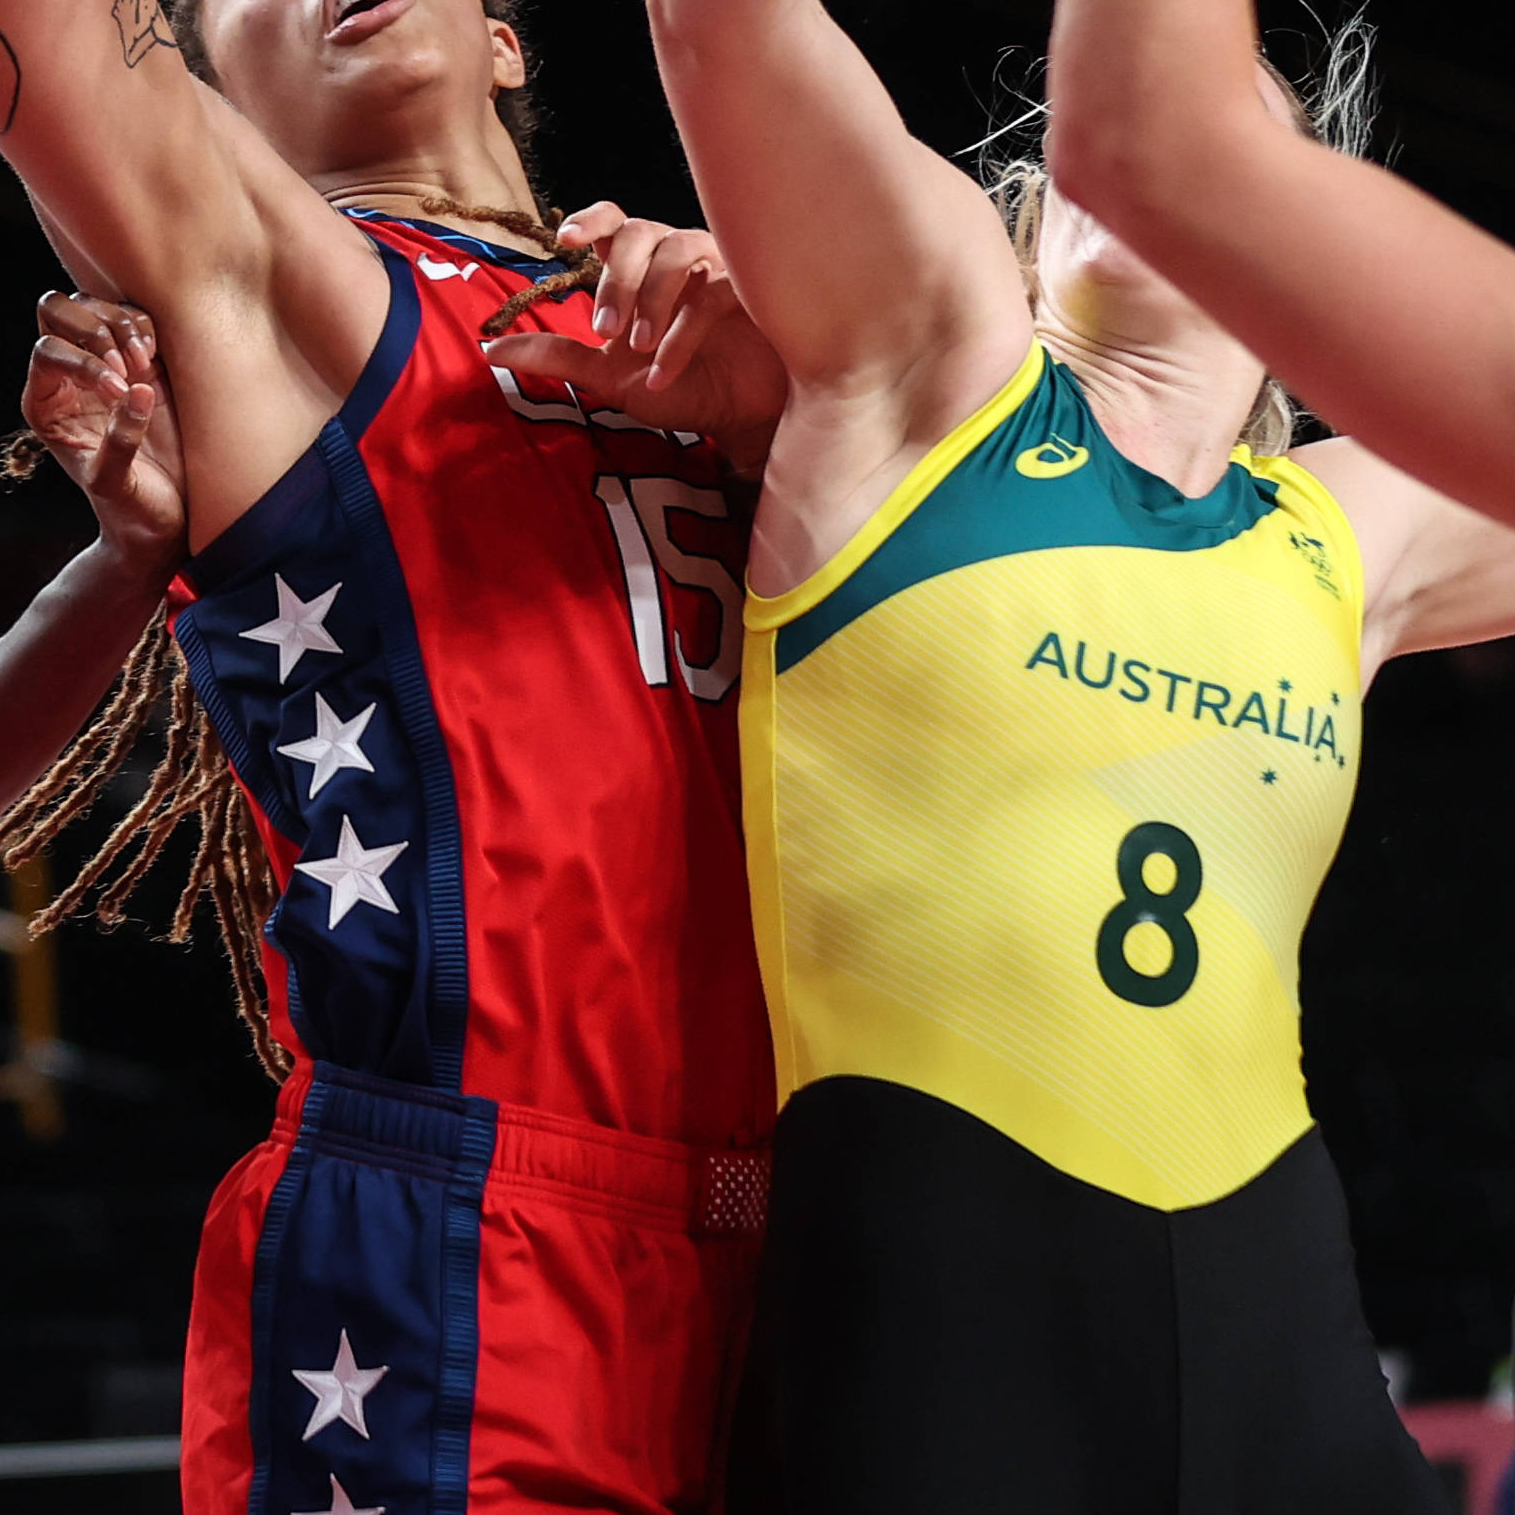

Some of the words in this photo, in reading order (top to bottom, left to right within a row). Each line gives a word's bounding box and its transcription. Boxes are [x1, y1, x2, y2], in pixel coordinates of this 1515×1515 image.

[594, 473, 745, 702] 15
[1025, 631, 1340, 753] AUSTRALIA
[1095, 820, 1203, 1008] 8
